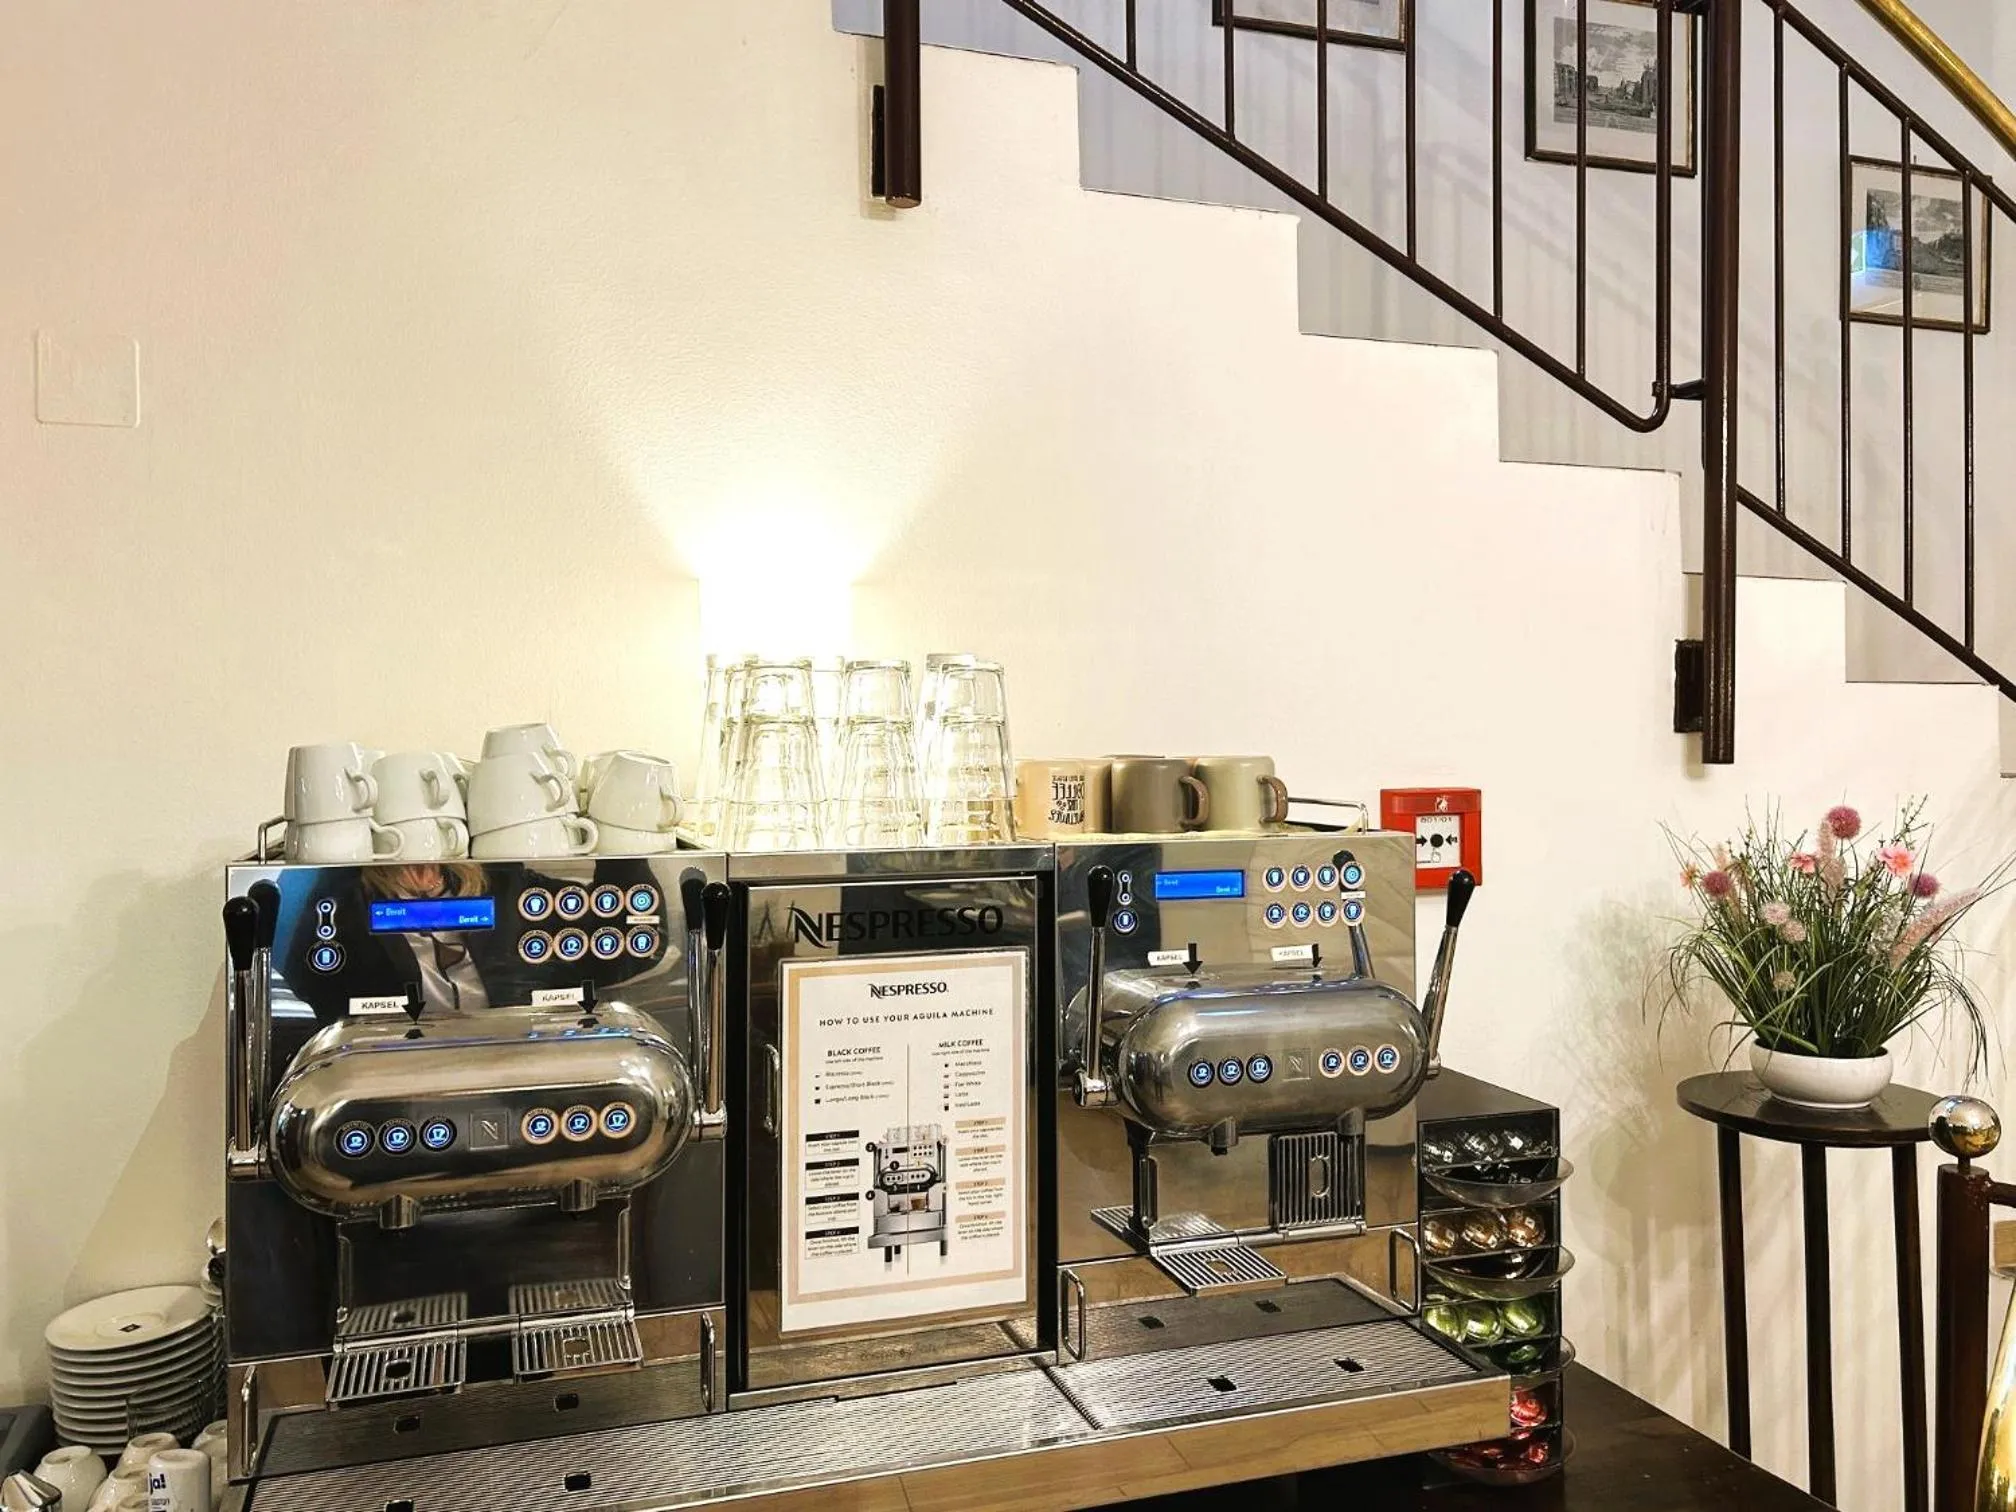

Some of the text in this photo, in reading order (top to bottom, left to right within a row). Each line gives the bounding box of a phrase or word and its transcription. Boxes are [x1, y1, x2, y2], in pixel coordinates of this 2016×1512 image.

[785, 904, 1004, 949] NESPRESSO
[868, 981, 948, 999] NESPRESSO
[360, 1000, 399, 1010] KAPSEL
[819, 1008, 993, 1027] HOW TO USE YOUR AGUILA MACHINE
[827, 1046, 881, 1057] BLACK COFFEE
[938, 1038, 984, 1048] MILK COFFEE
[148, 1472, 167, 1495] ja!
